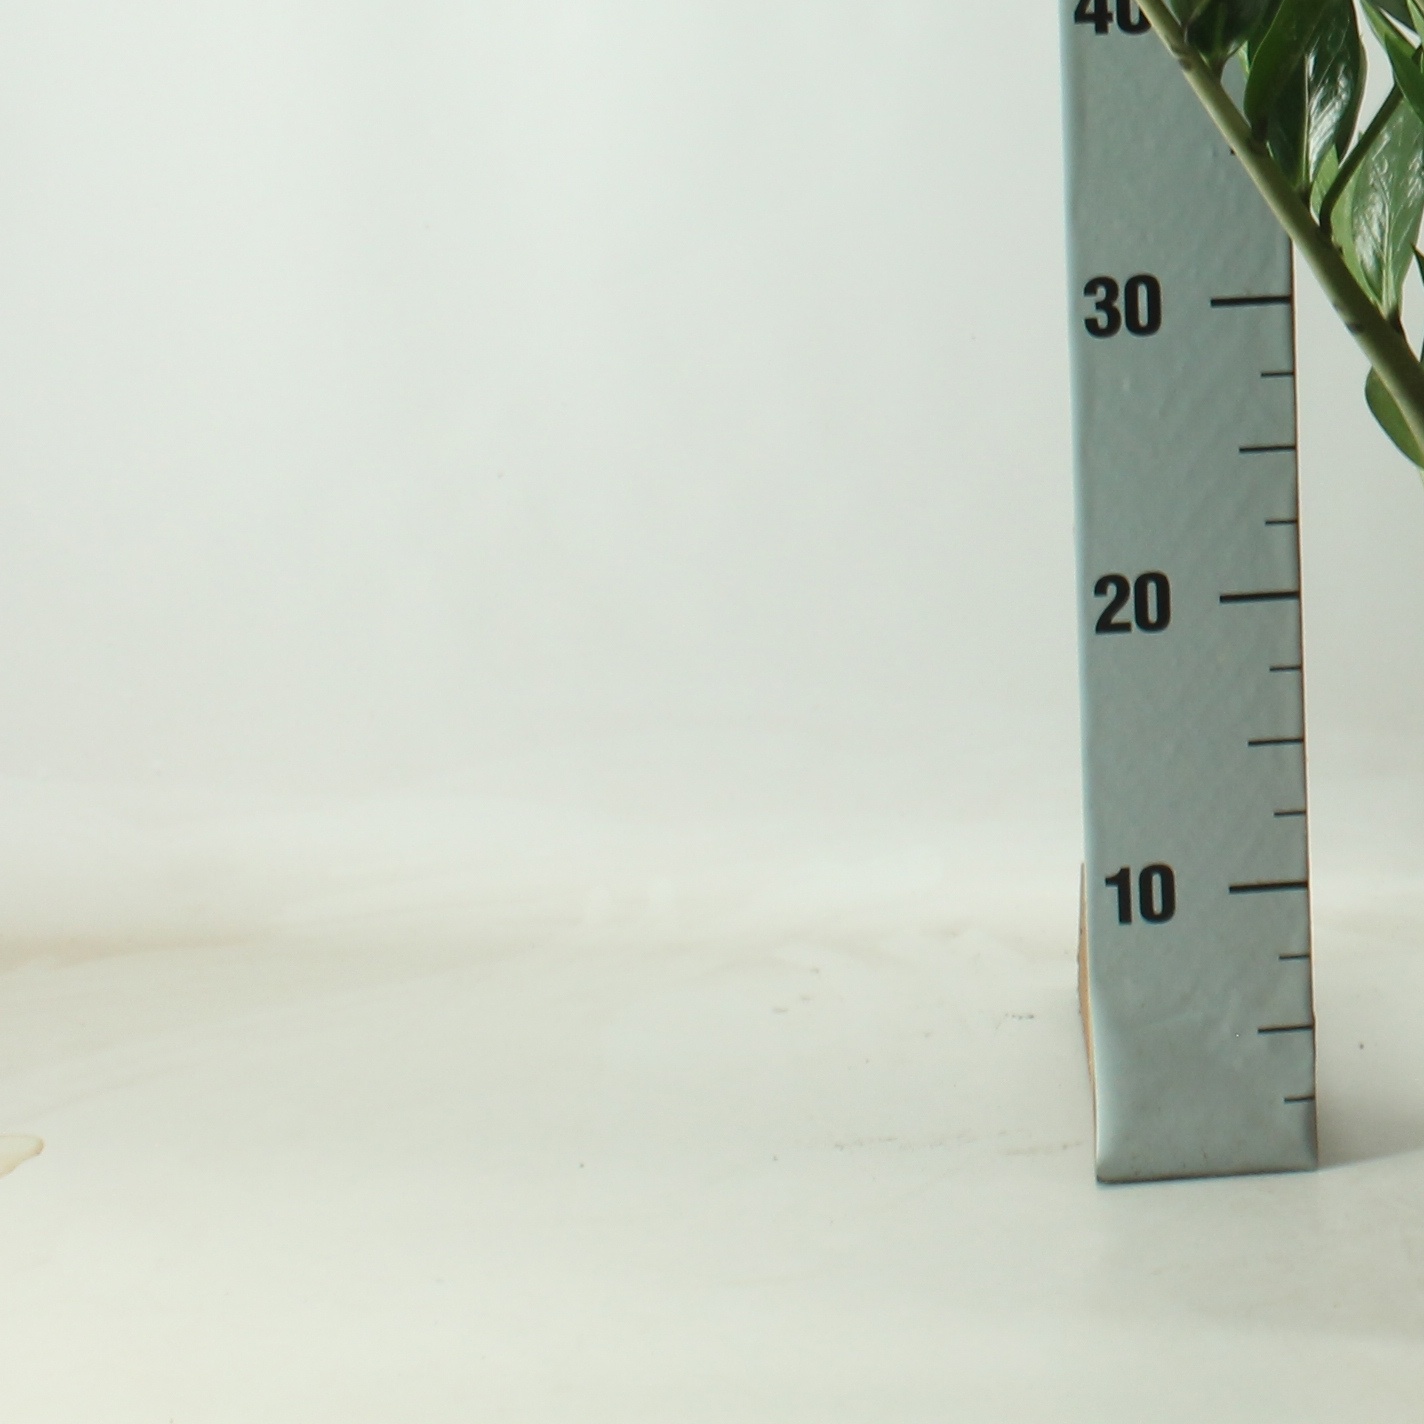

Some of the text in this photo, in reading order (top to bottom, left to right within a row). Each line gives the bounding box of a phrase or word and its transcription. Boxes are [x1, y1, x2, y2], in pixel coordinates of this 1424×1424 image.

[1083, 273, 1162, 339] 30
[1093, 570, 1171, 635] 20
[1104, 863, 1176, 925] 10
